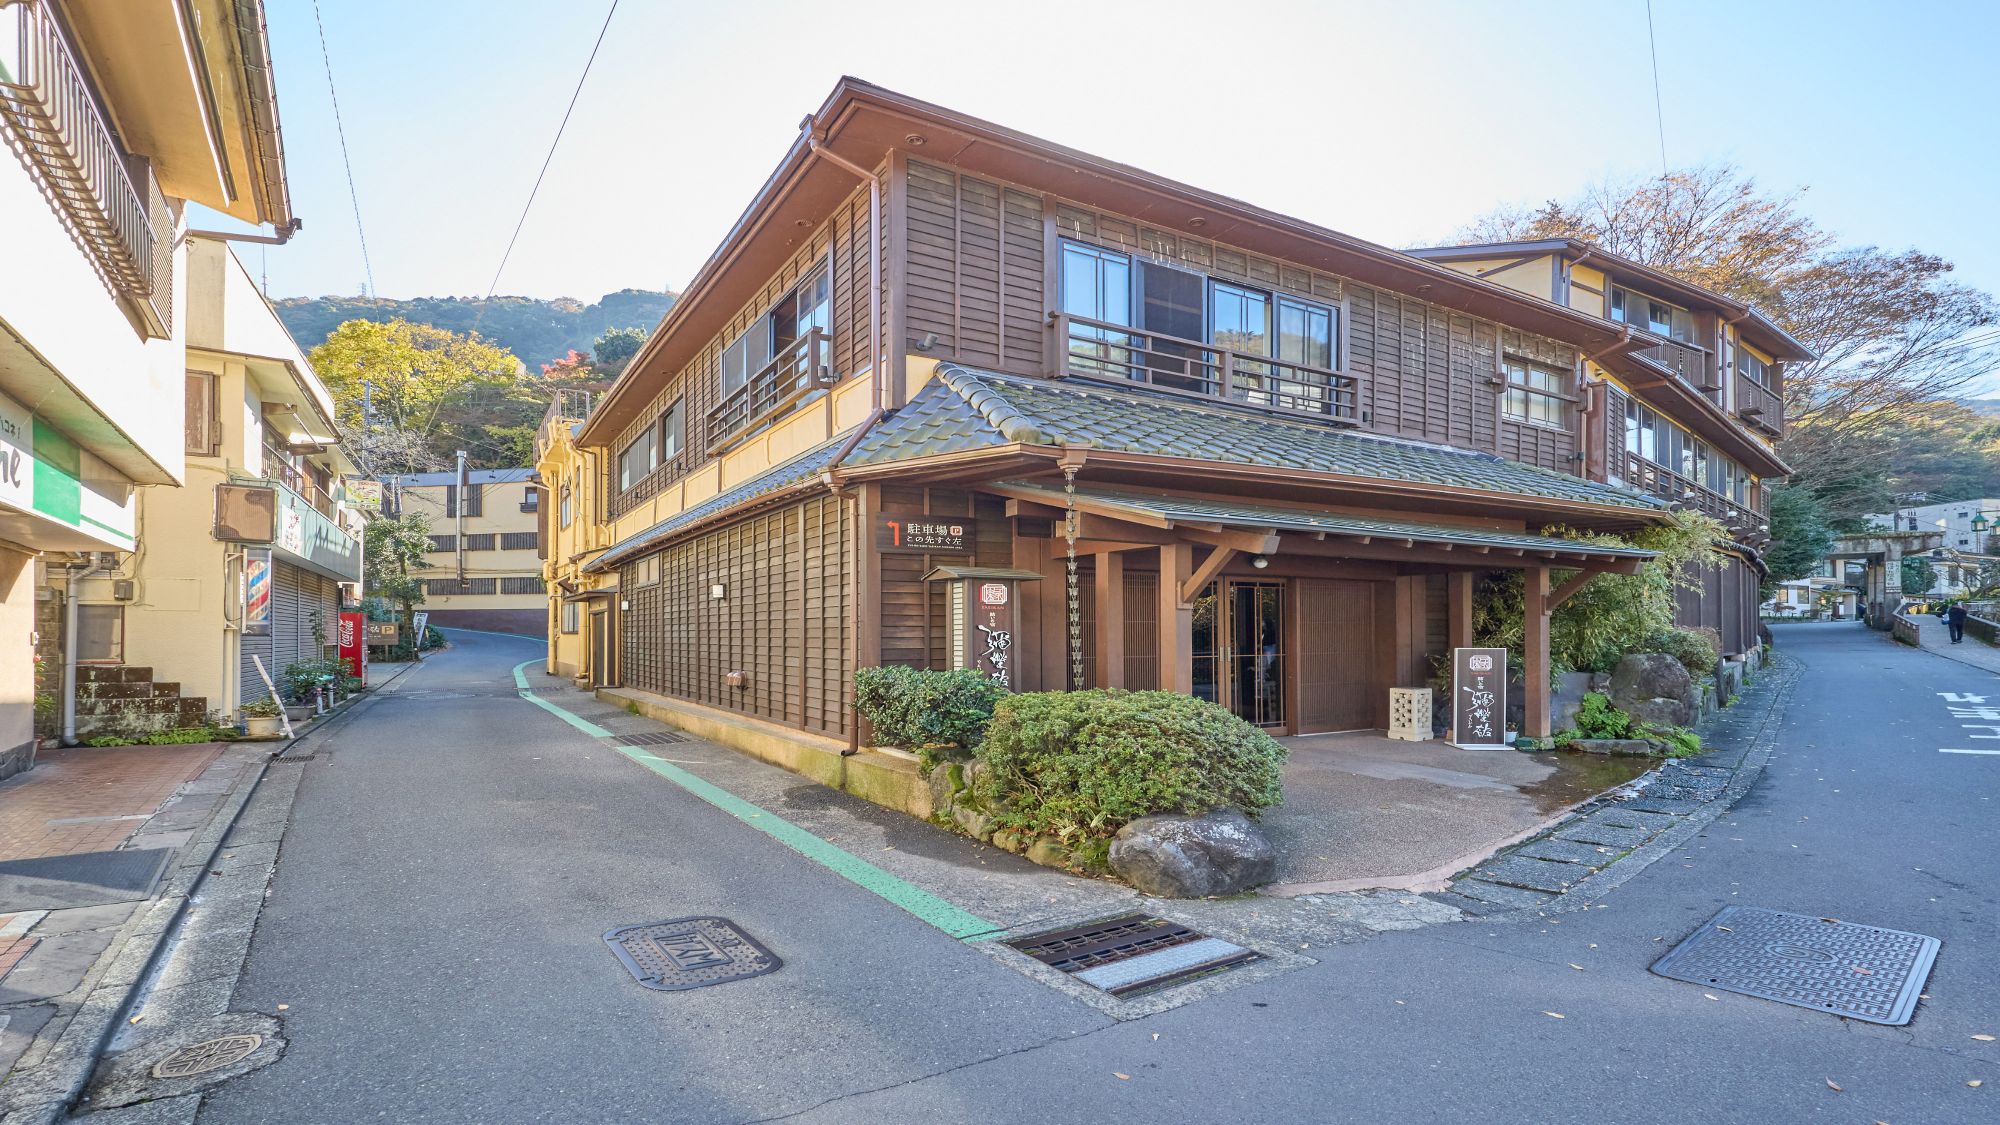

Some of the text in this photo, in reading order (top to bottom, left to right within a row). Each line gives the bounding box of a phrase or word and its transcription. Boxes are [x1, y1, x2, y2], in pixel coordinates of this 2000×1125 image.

[907, 523, 948, 536] 駐車場
[906, 535, 962, 546] この先すぐ左
